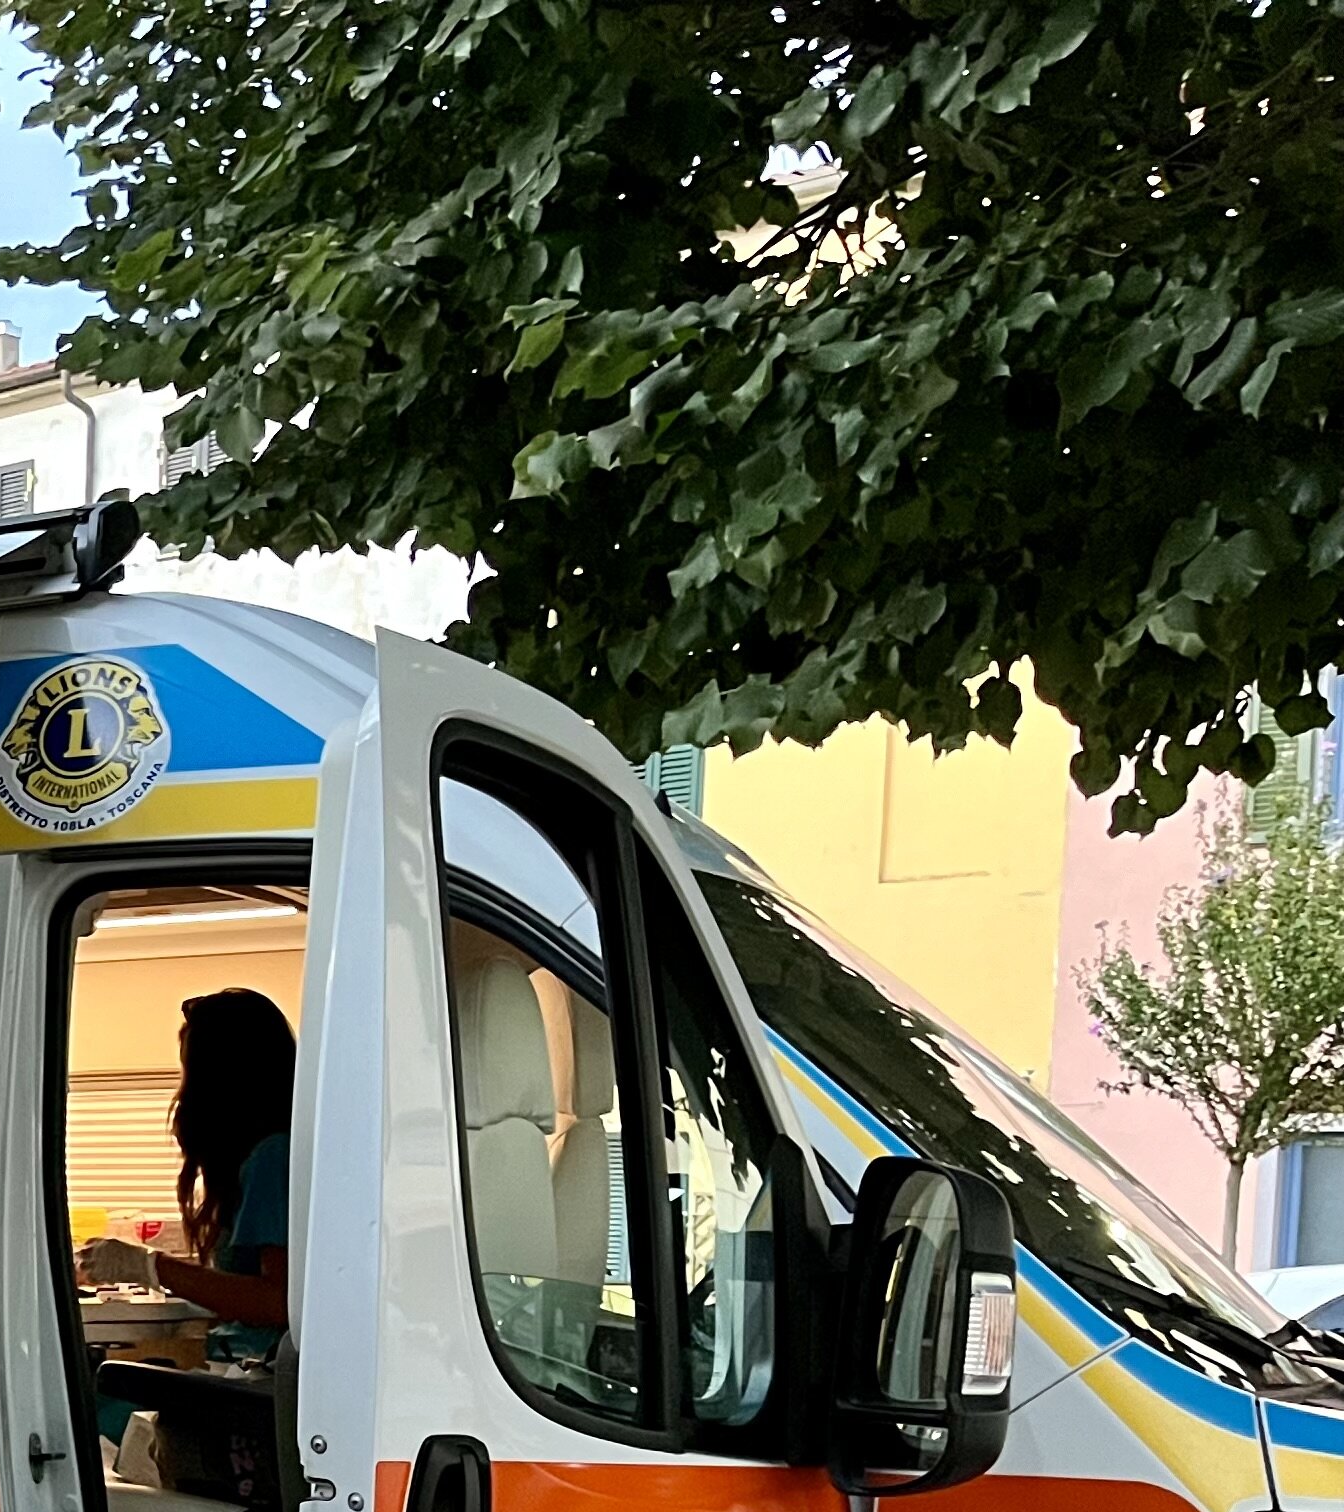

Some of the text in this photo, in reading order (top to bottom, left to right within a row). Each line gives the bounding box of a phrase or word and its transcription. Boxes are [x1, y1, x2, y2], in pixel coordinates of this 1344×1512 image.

[42, 667, 133, 702] LIONS
[63, 708, 102, 758] L
[32, 768, 122, 801] INTERNATIONAL
[52, 817, 97, 832] 108LA
[106, 761, 165, 819] TOSCANA
